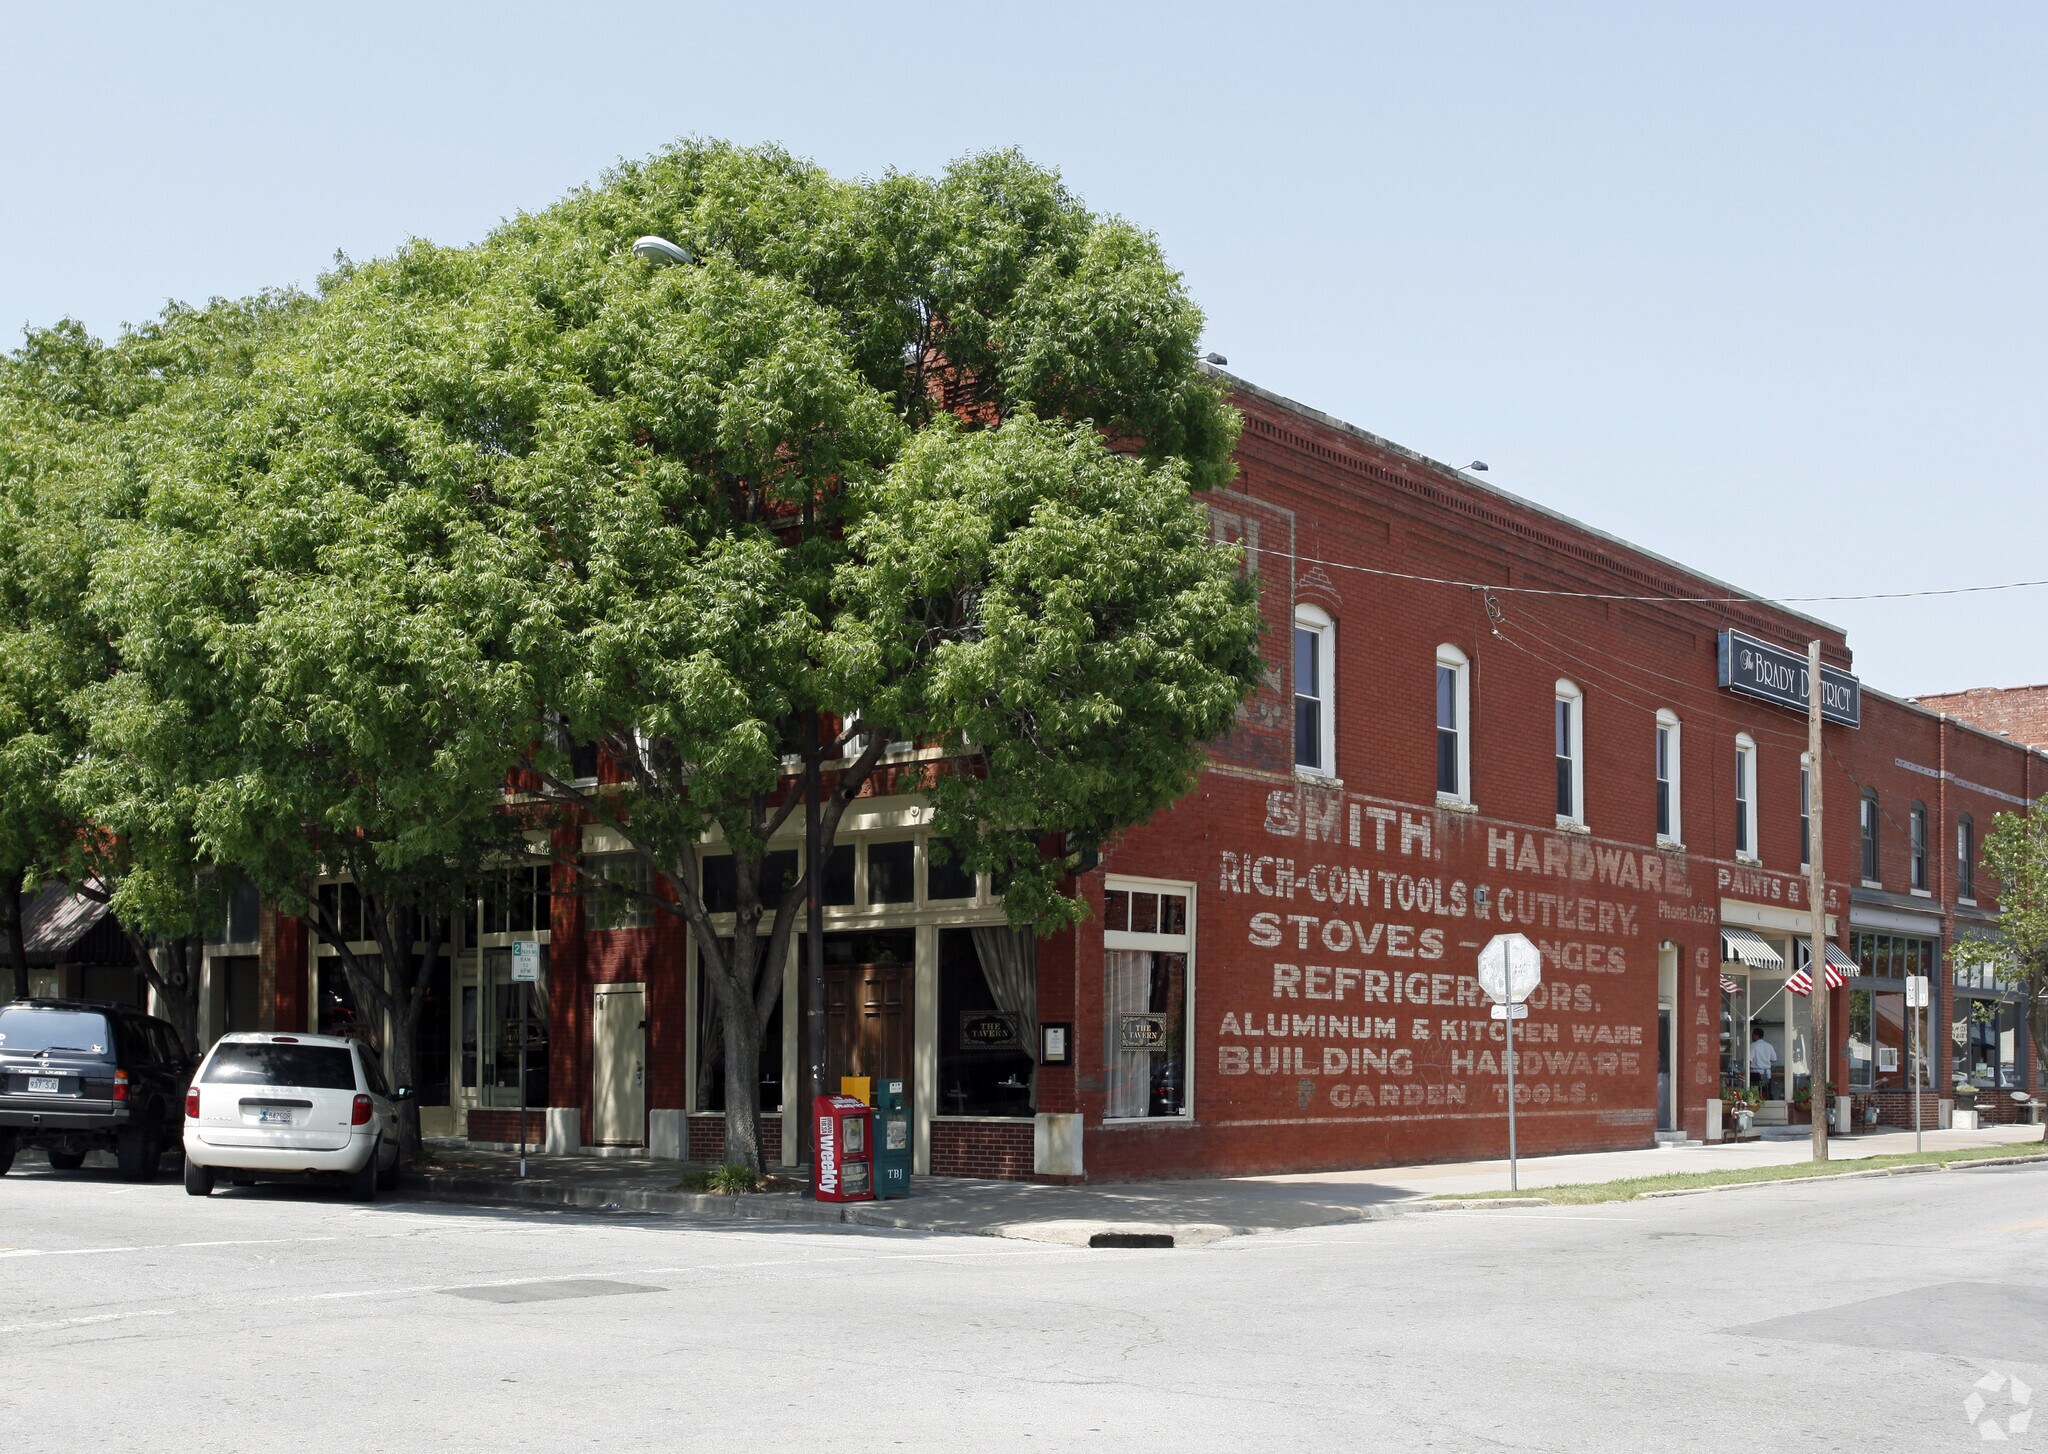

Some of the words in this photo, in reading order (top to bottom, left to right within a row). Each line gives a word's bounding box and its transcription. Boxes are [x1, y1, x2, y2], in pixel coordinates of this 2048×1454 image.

[1740, 649, 1754, 670] The
[1755, 653, 1795, 693] BRADY
[1801, 669, 1850, 711] DTRICT
[1264, 790, 1440, 860] SMITH.
[1220, 851, 1369, 906] RICH-CON
[1378, 871, 1467, 917] TOOLS
[1718, 868, 1781, 899] PAINTS
[1788, 882, 1799, 902] &
[514, 944, 520, 954] 2
[1248, 912, 1444, 959] STOVES
[1539, 939, 1626, 974] NGES
[1272, 963, 1601, 1013] REFRIGERORS.
[972, 1030, 1009, 1038] TAVERN
[980, 1022, 1001, 1030] THE
[1129, 1031, 1157, 1039] TAVERN
[1135, 1024, 1151, 1032] THE
[1219, 1012, 1396, 1039] ALUMINUM
[1412, 1019, 1429, 1040] &
[1441, 1019, 1558, 1042] KITCHEN
[1572, 1024, 1642, 1045] WARE
[1218, 1046, 1413, 1076] BUILDING
[1452, 1050, 1640, 1076] HARDWARE
[30, 1081, 42, 1089] 937
[1330, 1083, 1466, 1108] GARDEN
[1493, 1082, 1598, 1104] TOOLS.
[820, 1135, 838, 1194] Weekly
[887, 1169, 903, 1180] TBJ
